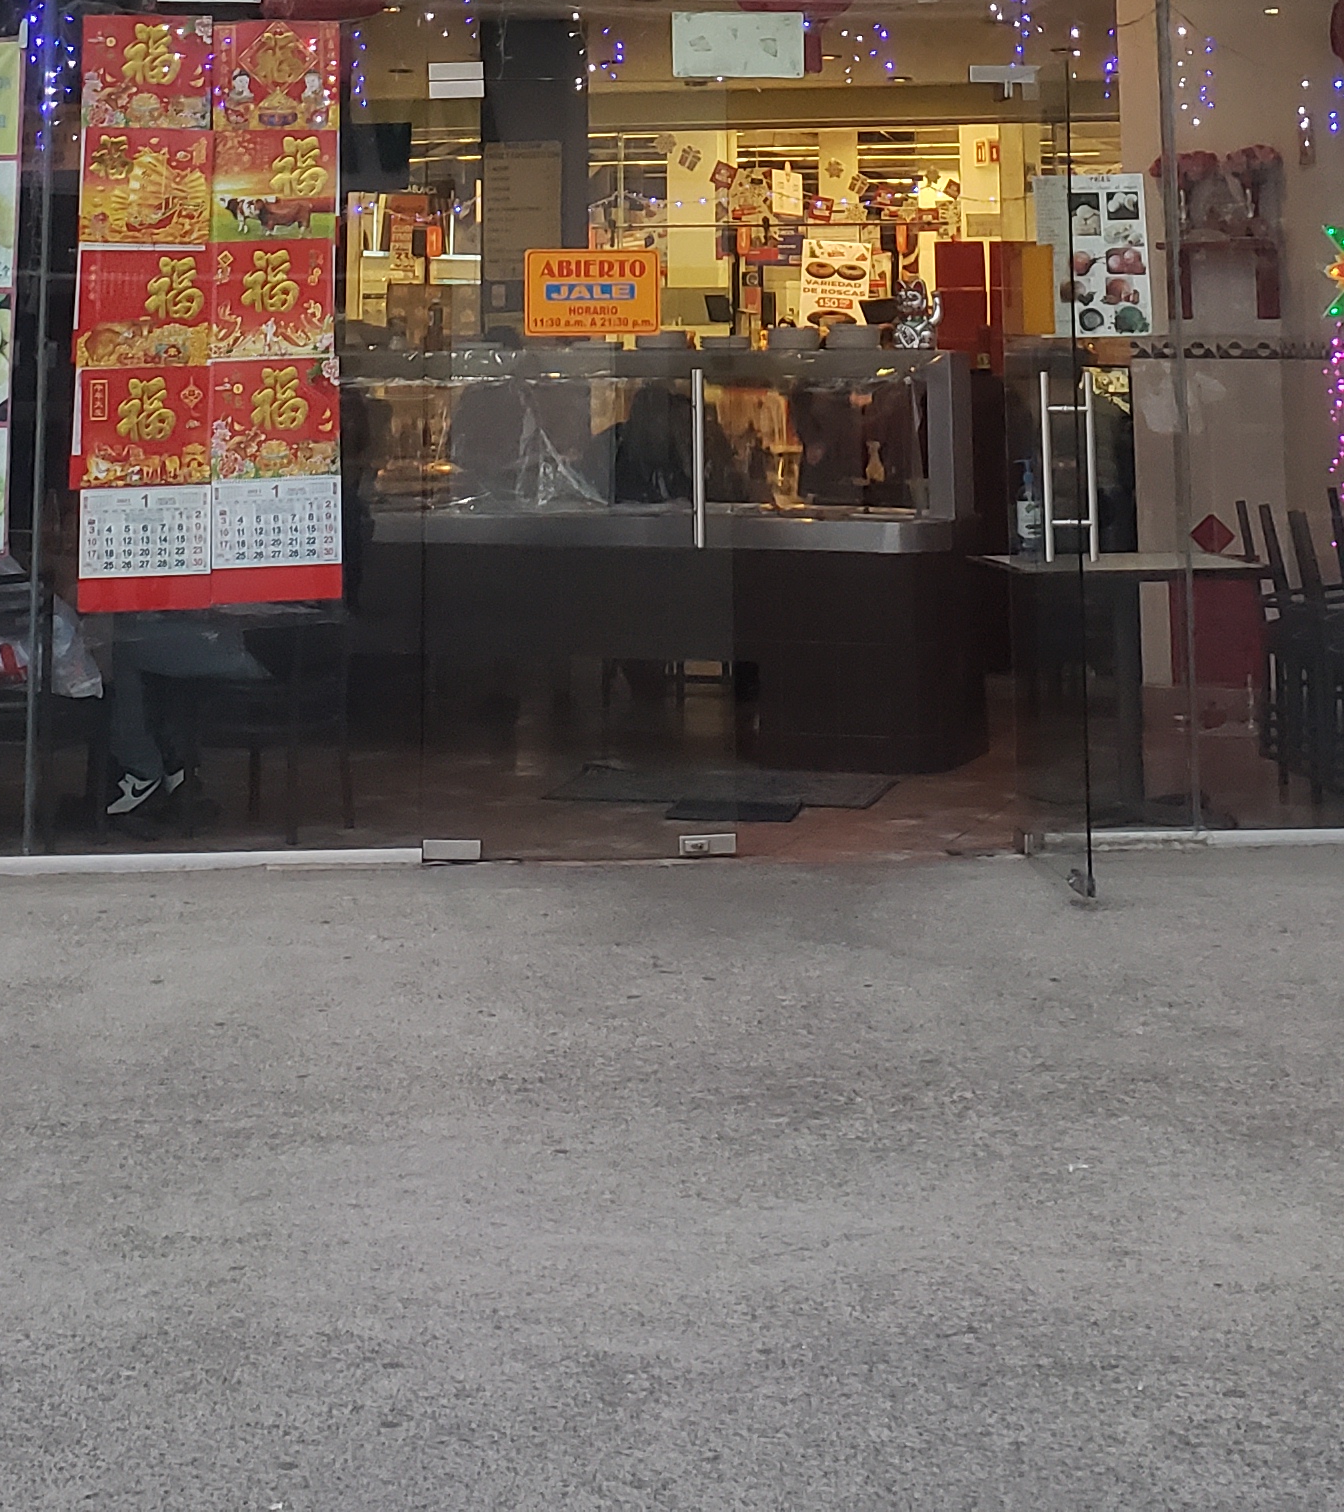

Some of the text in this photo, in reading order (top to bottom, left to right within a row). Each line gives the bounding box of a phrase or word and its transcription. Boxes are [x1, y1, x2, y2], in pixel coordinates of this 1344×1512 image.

[539, 259, 646, 278] ABIERTO
[805, 279, 862, 288] VARIEDAD
[550, 284, 631, 300] JALE
[569, 306, 618, 316] HORARIO
[271, 484, 279, 498] 1
[141, 494, 149, 508] 1
